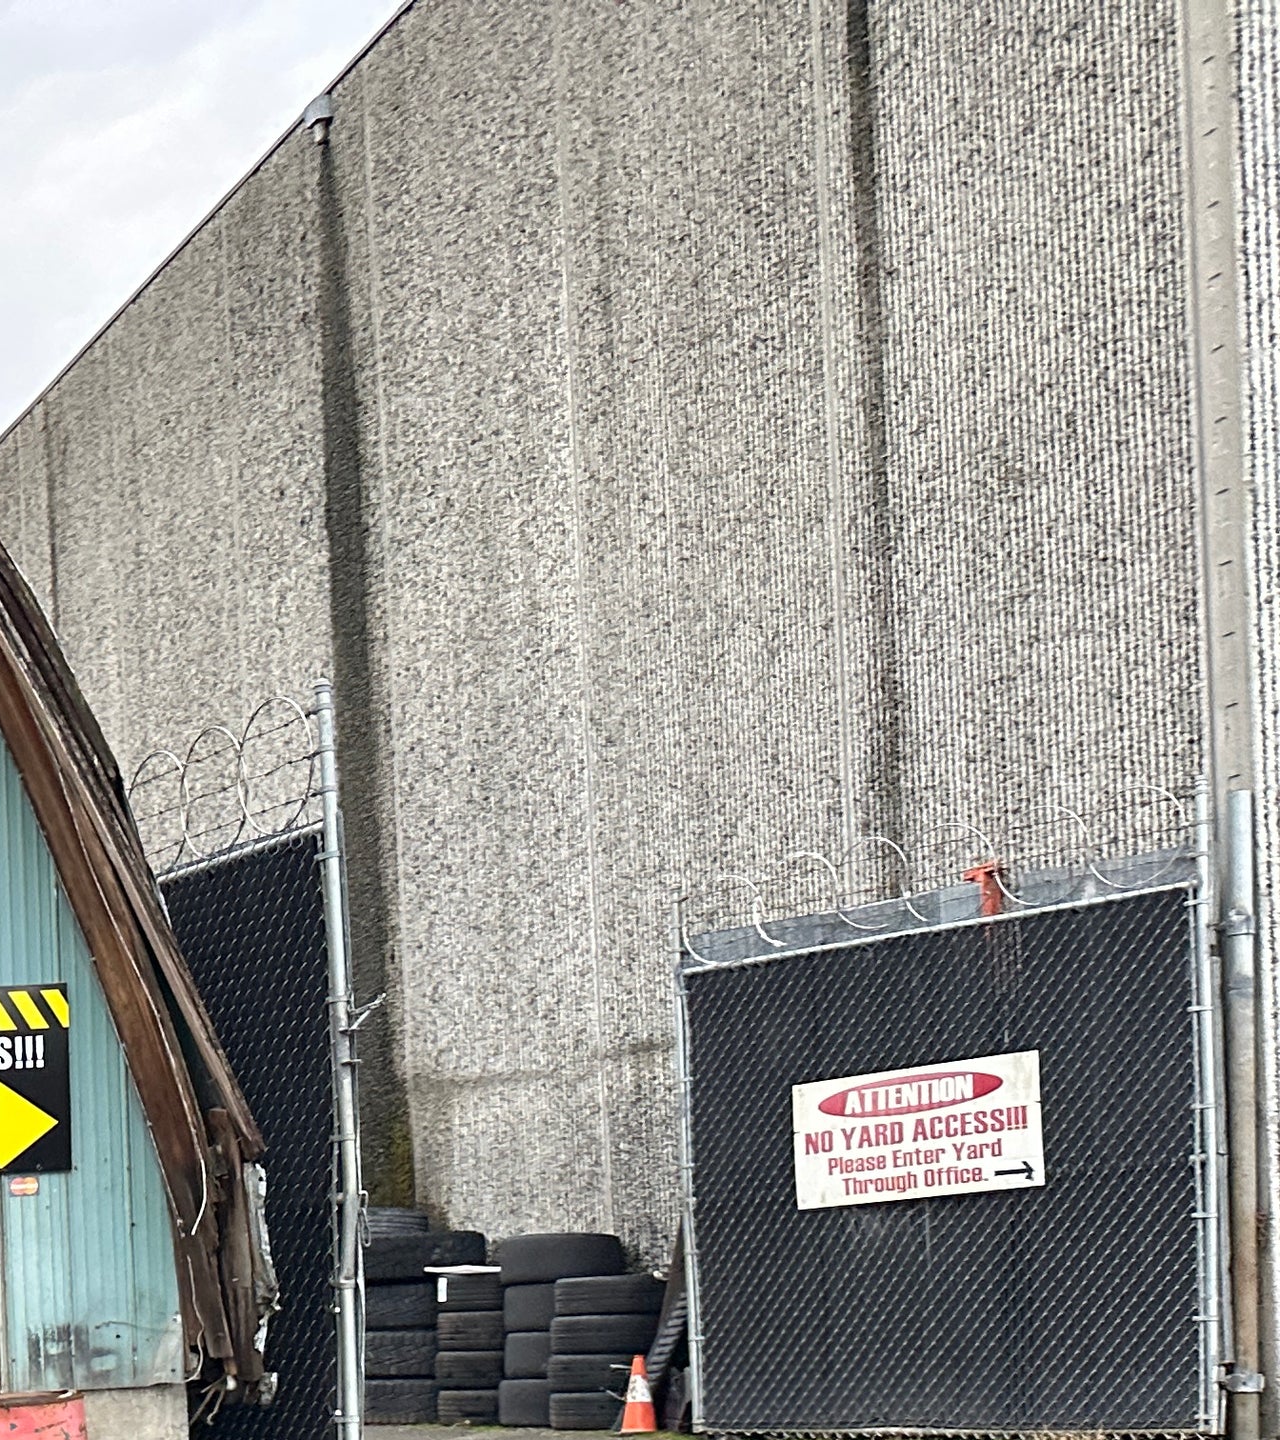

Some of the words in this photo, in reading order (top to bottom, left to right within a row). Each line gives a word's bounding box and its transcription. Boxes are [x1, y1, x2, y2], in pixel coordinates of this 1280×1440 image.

[844, 1074, 974, 1116] ATTENTION
[805, 1131, 834, 1155] NO
[841, 1121, 904, 1150] YARD
[912, 1105, 1028, 1142] ACCESS!!!
[828, 1151, 886, 1175] Please
[892, 1147, 946, 1168] Enter
[952, 1138, 1003, 1161] Yard
[842, 1171, 918, 1196] Through
